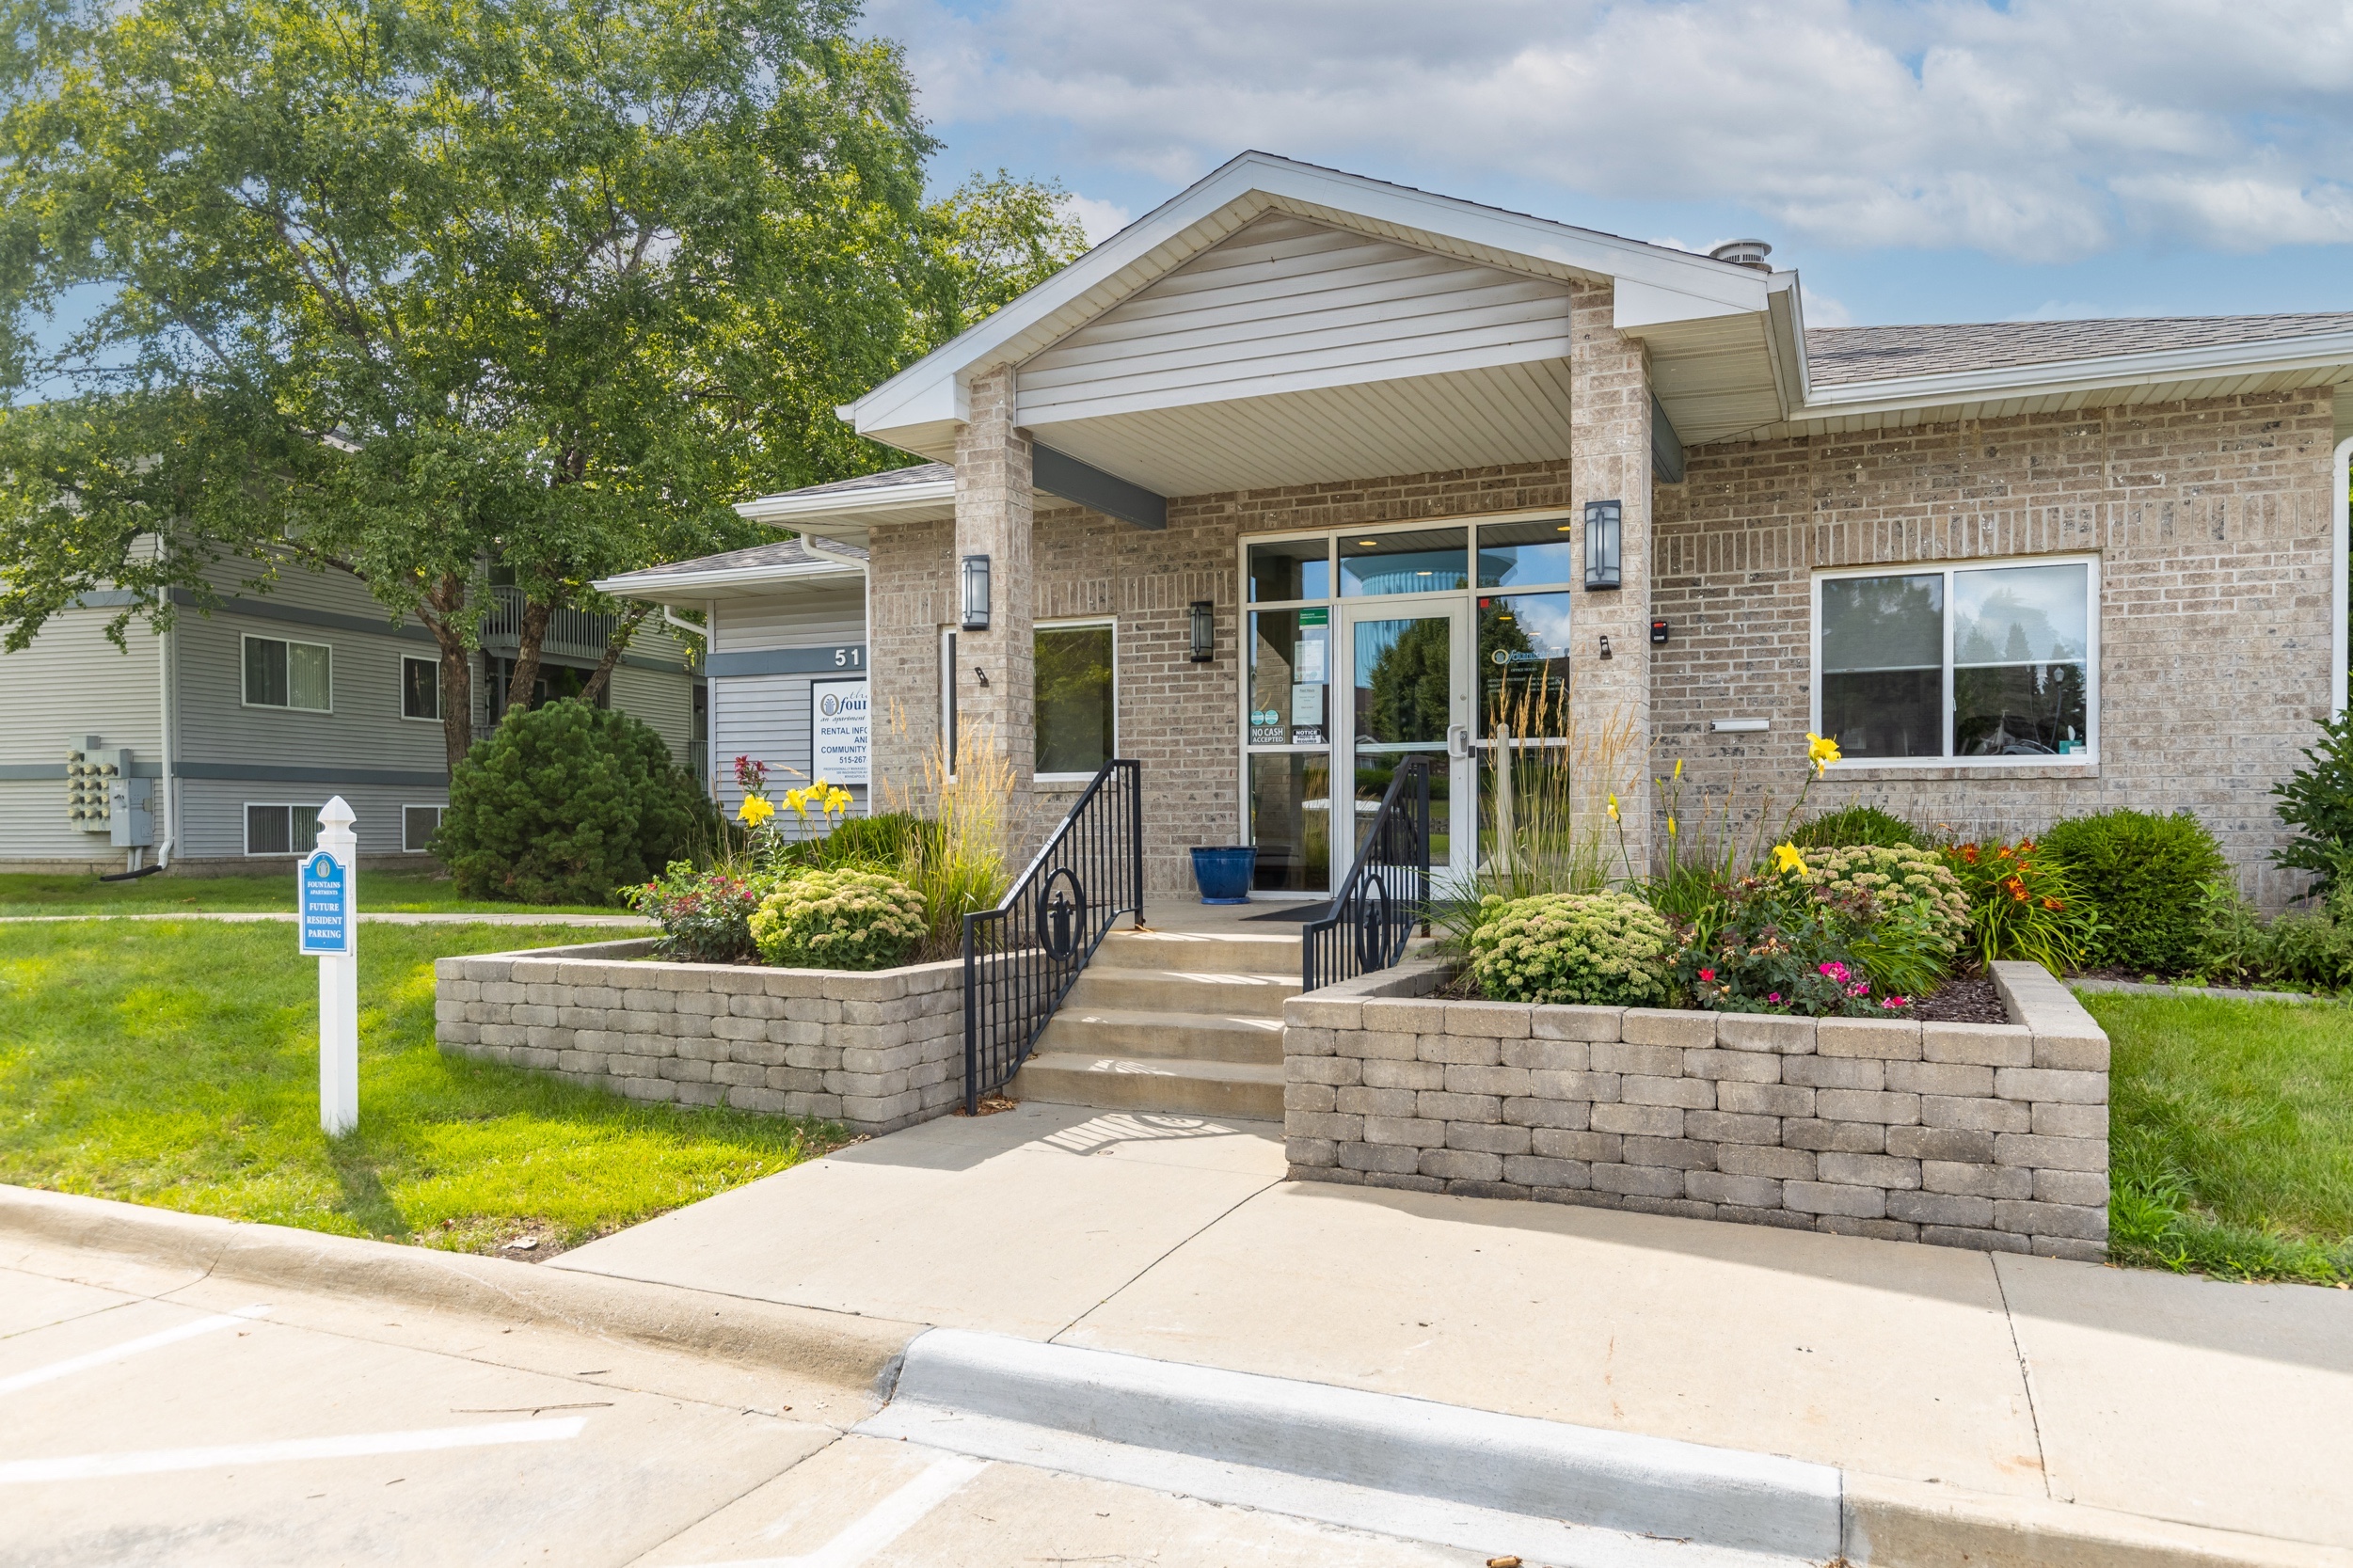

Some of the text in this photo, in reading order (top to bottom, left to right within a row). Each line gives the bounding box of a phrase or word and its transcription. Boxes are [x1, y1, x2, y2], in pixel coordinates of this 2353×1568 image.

[1264, 728, 1283, 736] CASH
[309, 903, 339, 911] FUTURE
[307, 916, 342, 925] RESIDENT
[308, 930, 341, 938] PARKING
